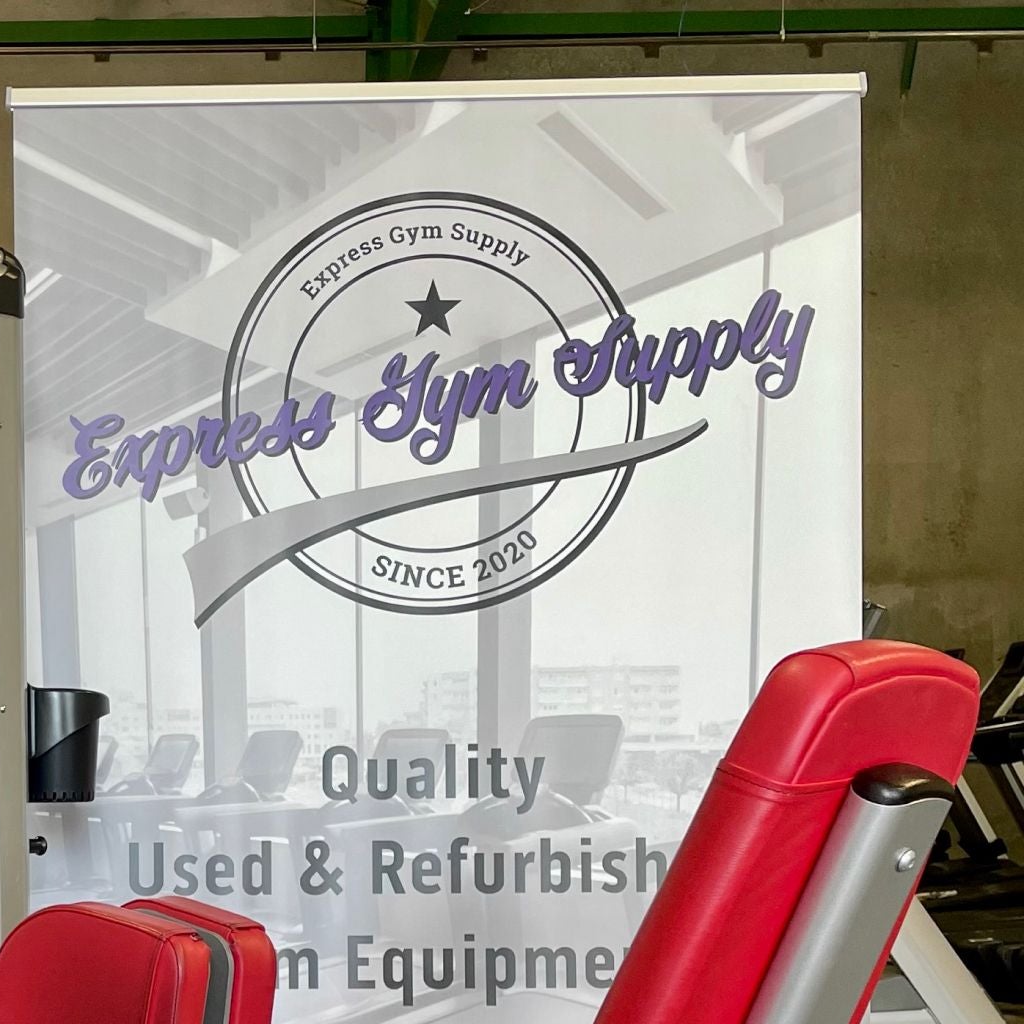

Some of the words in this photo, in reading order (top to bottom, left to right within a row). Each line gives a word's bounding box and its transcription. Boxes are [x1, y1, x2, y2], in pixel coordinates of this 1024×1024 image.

[300, 236, 384, 300] Express
[390, 225, 443, 245] Gym
[450, 223, 530, 267] Supply
[62, 392, 336, 502] Express
[359, 351, 538, 465] Gym
[553, 289, 815, 404] Supply
[371, 555, 465, 589] SINCE
[473, 530, 537, 582] 2020
[322, 743, 545, 814] Quality
[128, 840, 272, 896] Used
[299, 840, 344, 896] &
[372, 837, 667, 895] Refurbish
[347, 934, 629, 1006] Equipme
